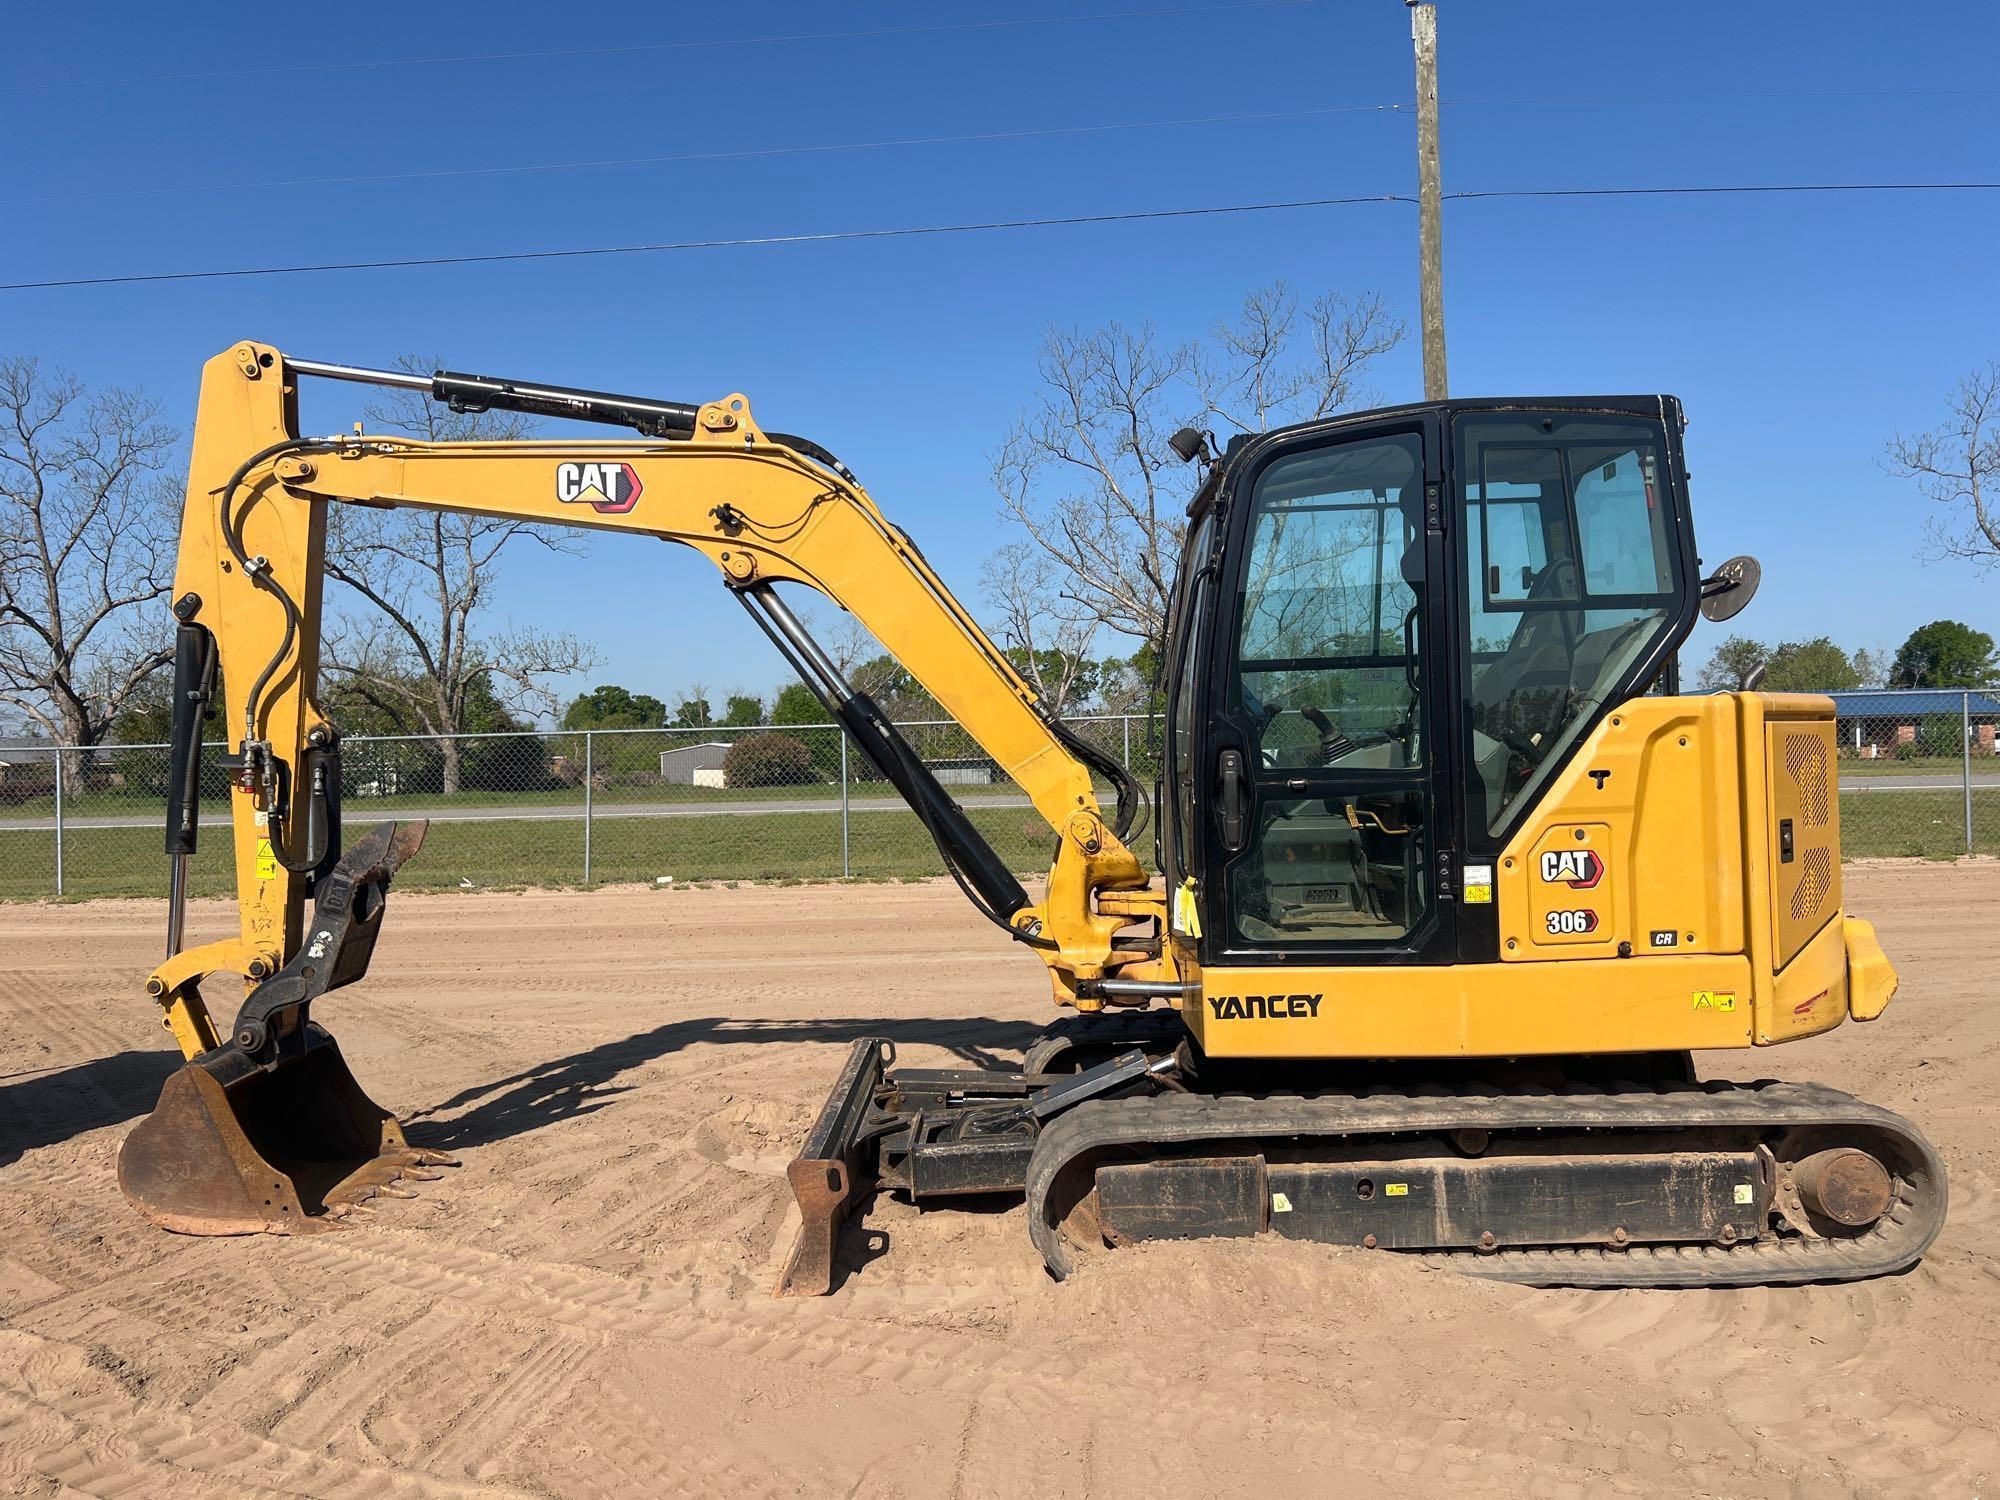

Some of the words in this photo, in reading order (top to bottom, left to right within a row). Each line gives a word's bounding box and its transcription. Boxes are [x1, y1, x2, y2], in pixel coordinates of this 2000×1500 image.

[557, 463, 622, 502] CAT
[1541, 851, 1588, 881] CAT
[1547, 911, 1587, 933] 306
[1655, 933, 1673, 945] CR
[1207, 994, 1323, 1019] YANCEY
